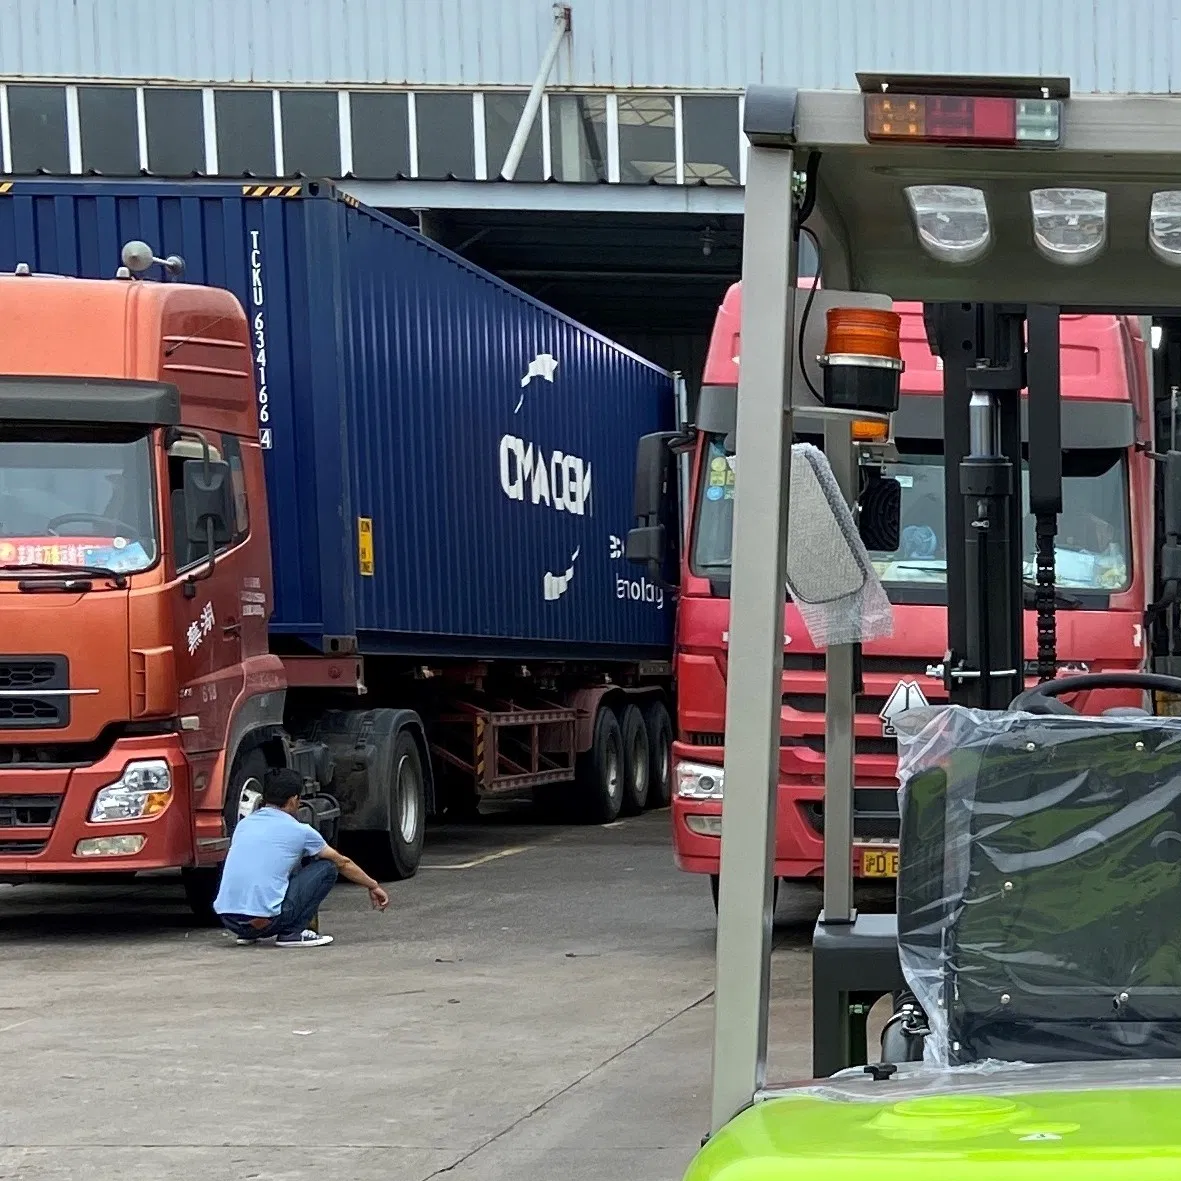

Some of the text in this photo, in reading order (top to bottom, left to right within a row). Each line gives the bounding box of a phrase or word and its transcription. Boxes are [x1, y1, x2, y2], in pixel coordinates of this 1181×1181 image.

[250, 230, 271, 449] TCKU 634166 4
